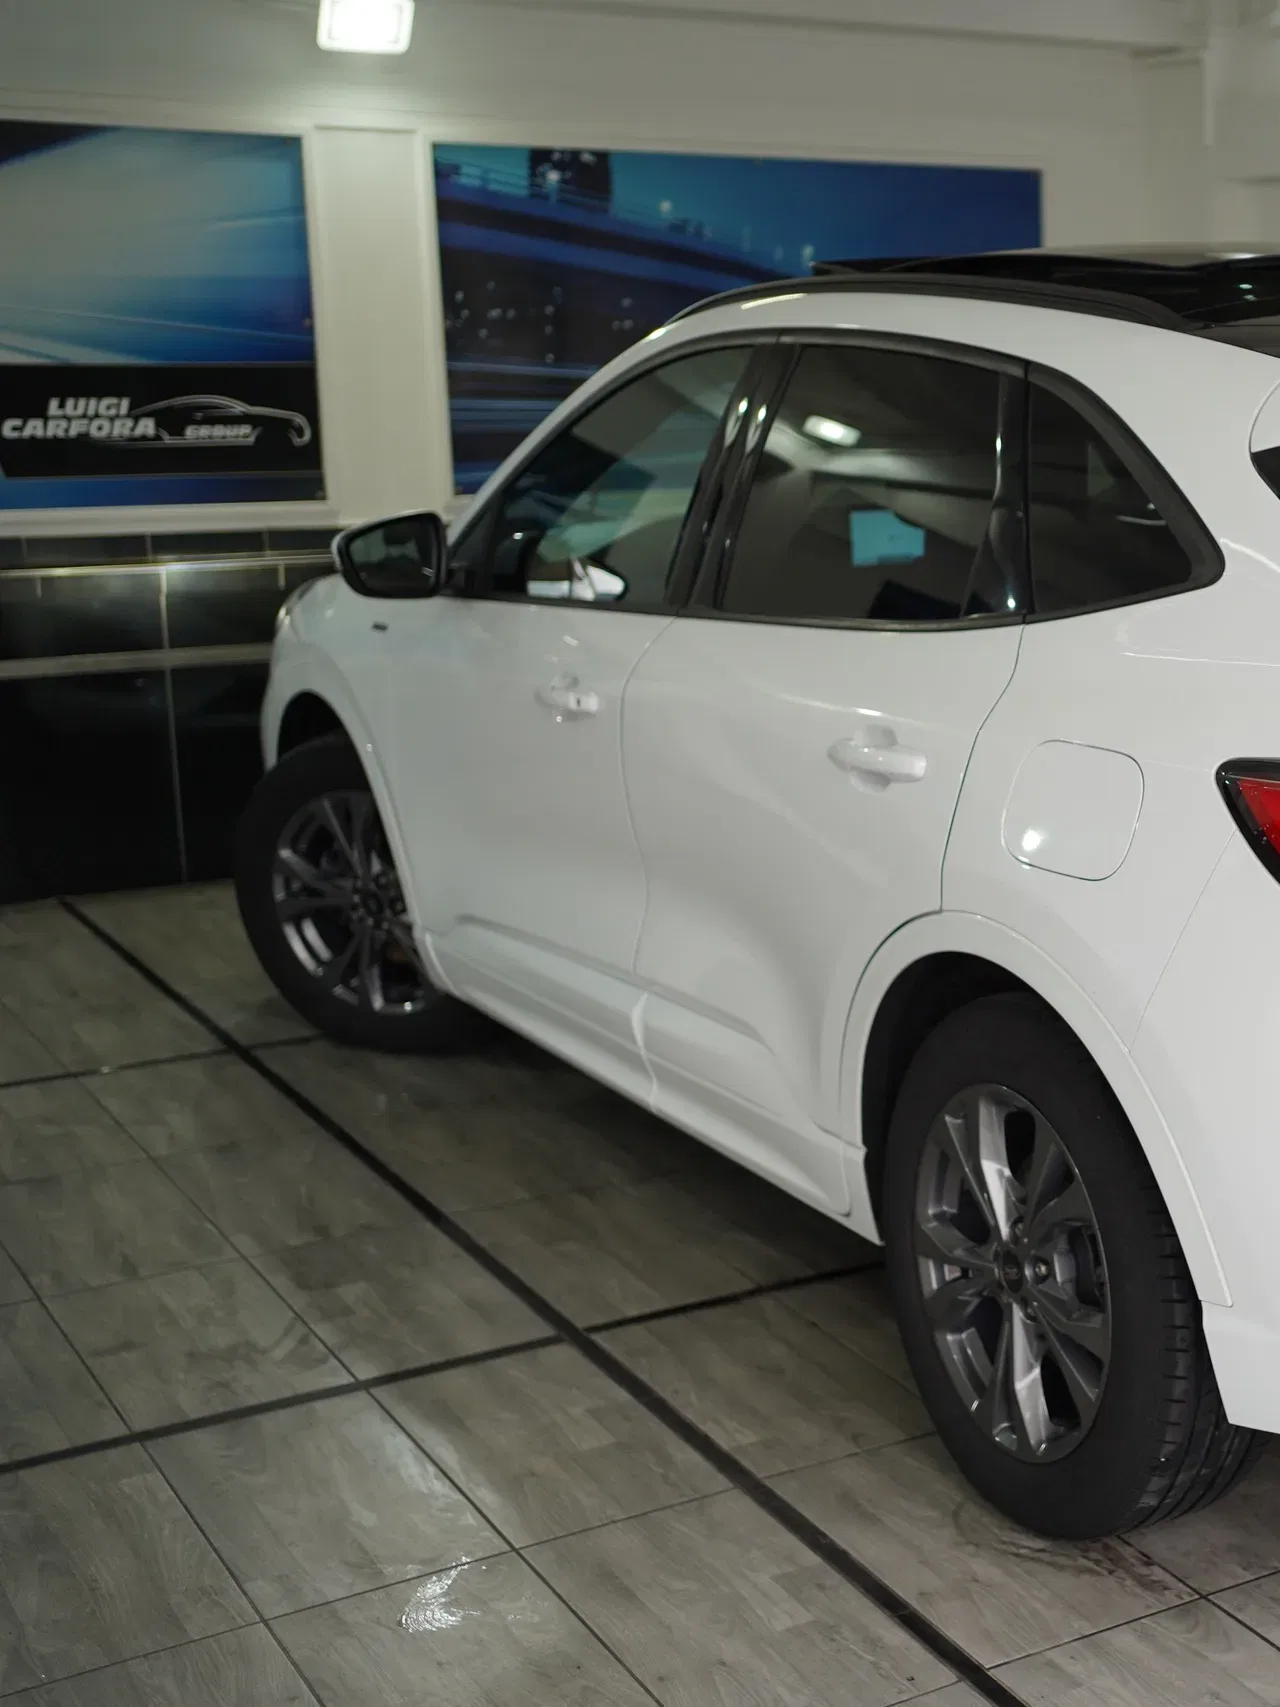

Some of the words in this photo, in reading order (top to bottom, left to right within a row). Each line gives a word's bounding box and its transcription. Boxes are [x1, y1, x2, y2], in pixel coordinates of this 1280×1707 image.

[47, 397, 131, 417] LUIGI
[1, 416, 157, 440] CARFORA
[184, 424, 252, 440] GROUP
